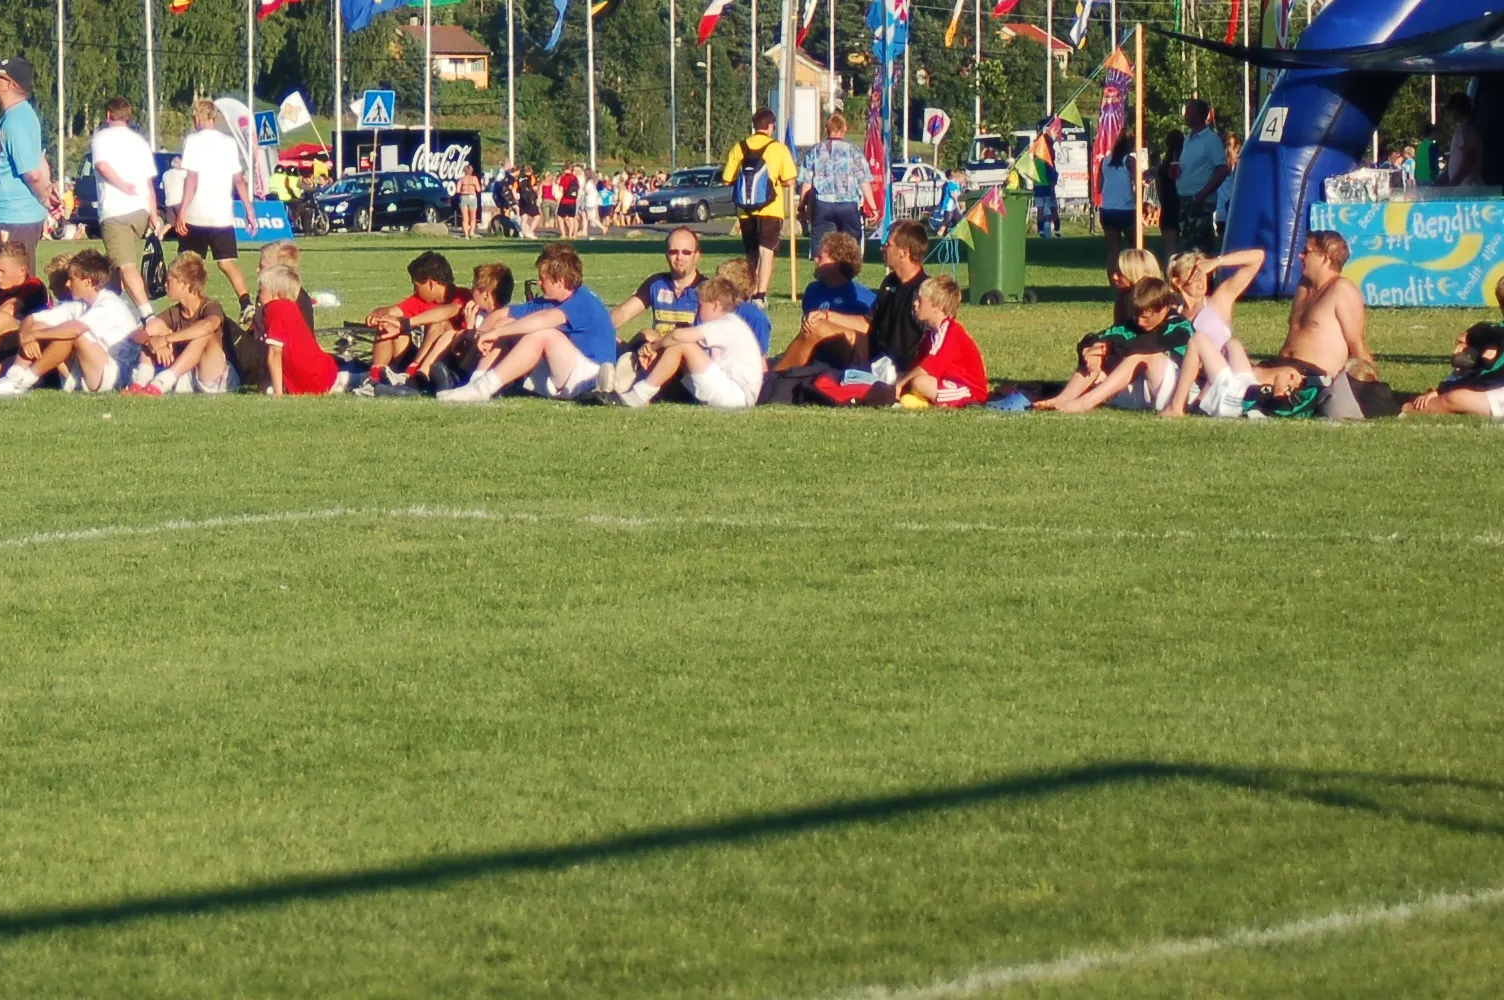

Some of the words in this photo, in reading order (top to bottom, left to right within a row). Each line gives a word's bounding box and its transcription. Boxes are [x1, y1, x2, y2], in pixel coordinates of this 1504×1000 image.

[1265, 116, 1278, 137] 4
[1412, 204, 1481, 238] Bendit
[1365, 275, 1435, 306] Bendit
